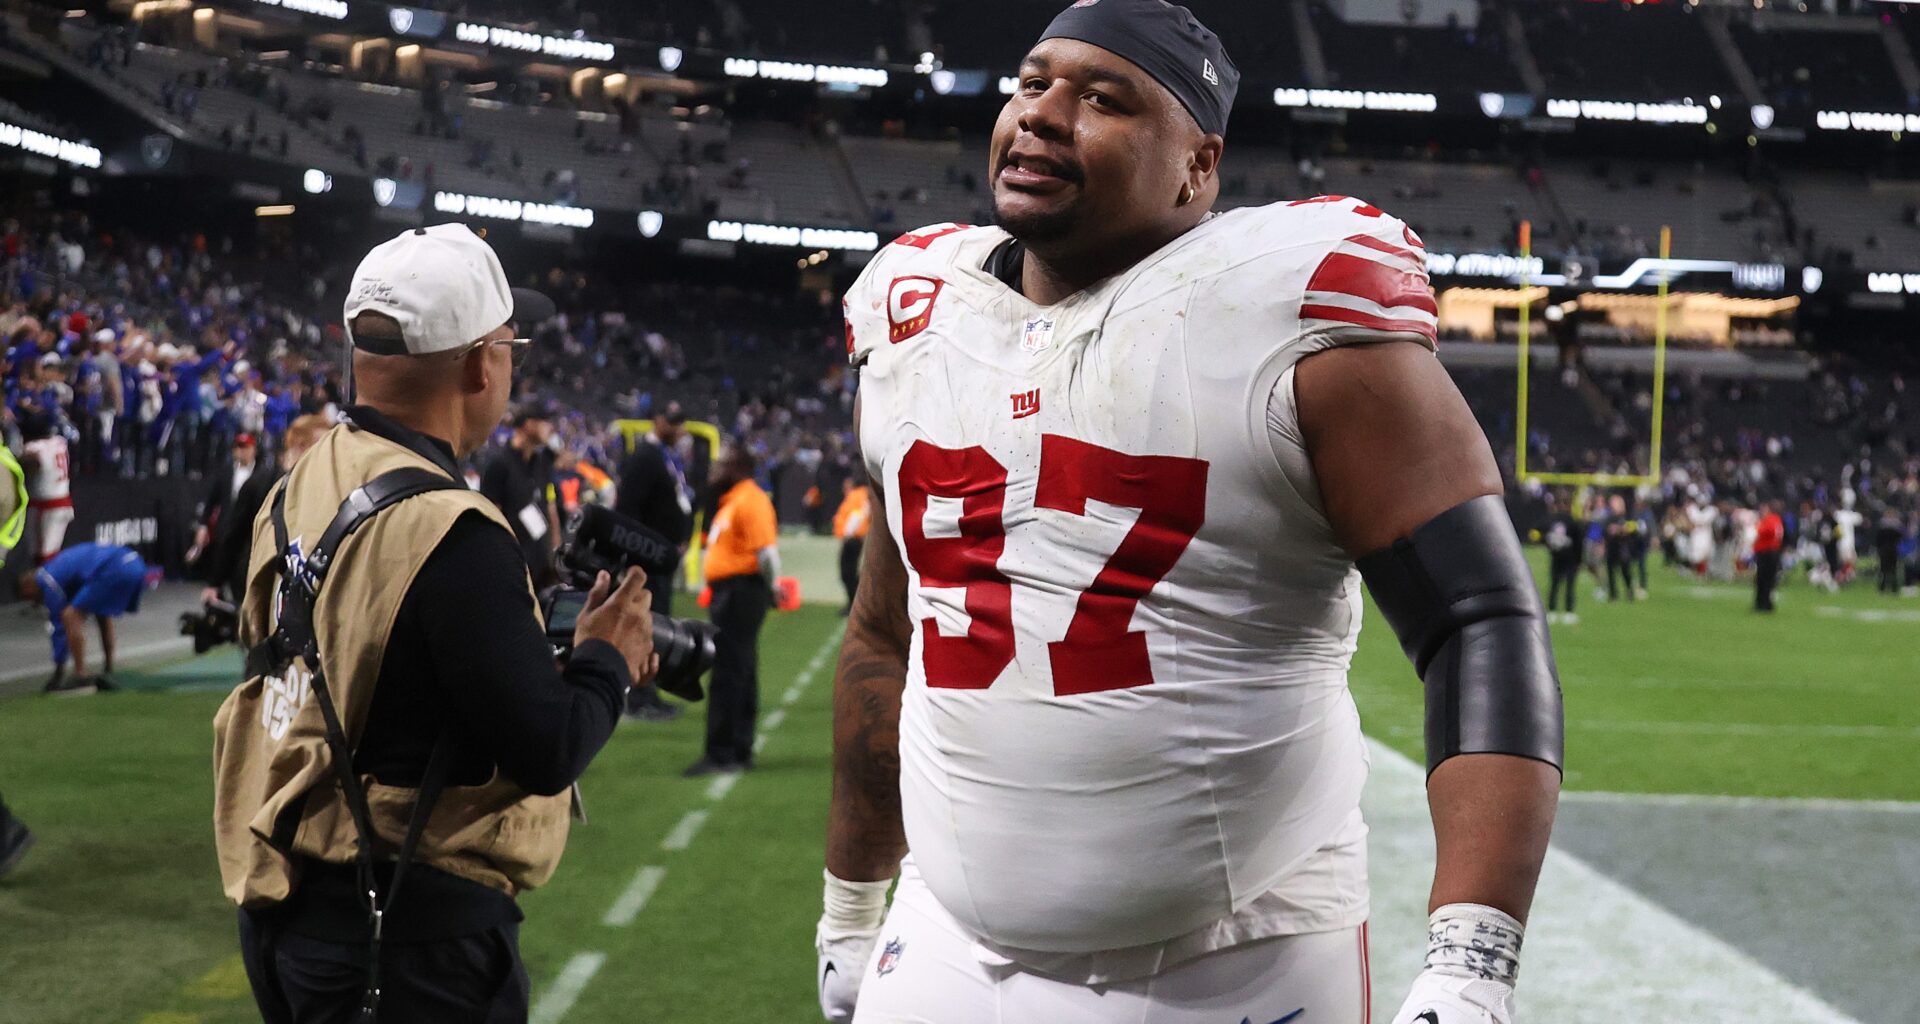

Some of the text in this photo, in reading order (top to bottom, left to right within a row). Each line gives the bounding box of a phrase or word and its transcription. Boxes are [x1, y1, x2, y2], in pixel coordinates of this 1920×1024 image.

[890, 279, 936, 324] C
[1026, 332, 1048, 347] NFL
[898, 433, 1210, 696] 97
